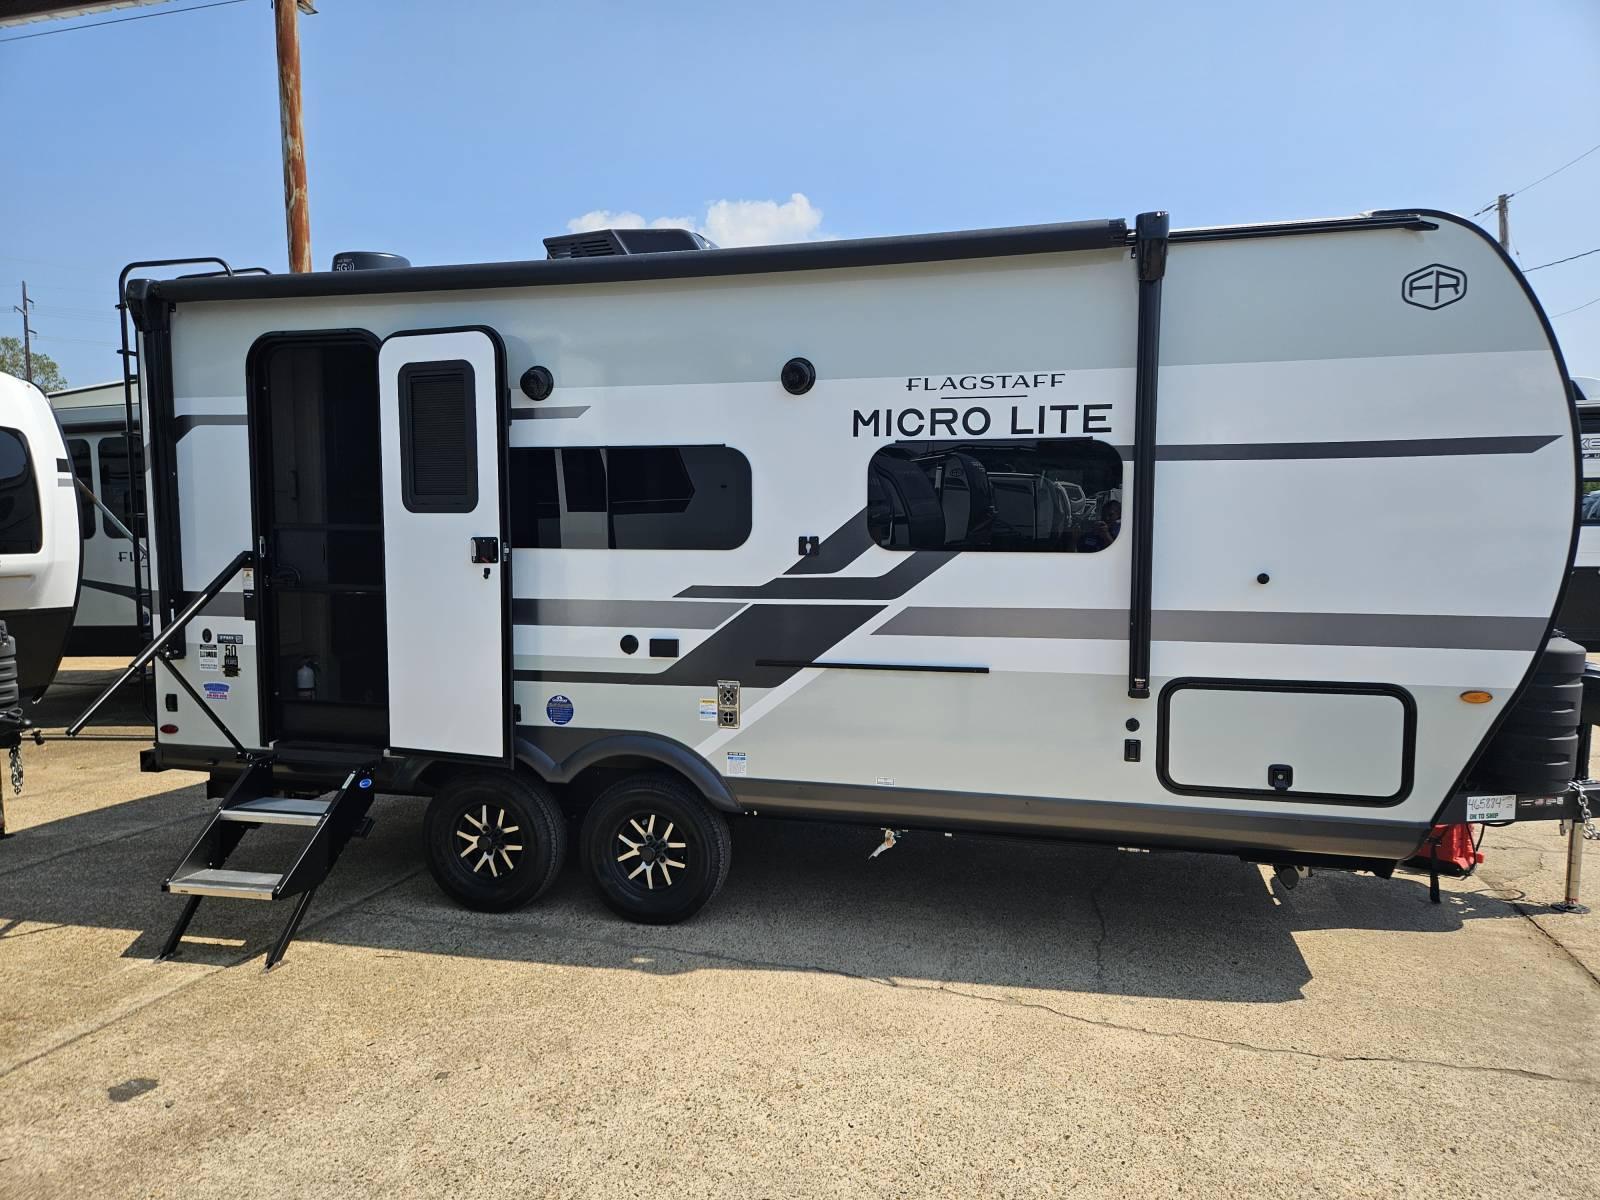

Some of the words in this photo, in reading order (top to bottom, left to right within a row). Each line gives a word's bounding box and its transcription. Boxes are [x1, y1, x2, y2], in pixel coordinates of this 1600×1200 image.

[906, 373, 1066, 391] FLAGSTAFF
[853, 407, 991, 437] MICRO
[1011, 404, 1112, 437] LITE
[225, 644, 237, 656] 50
